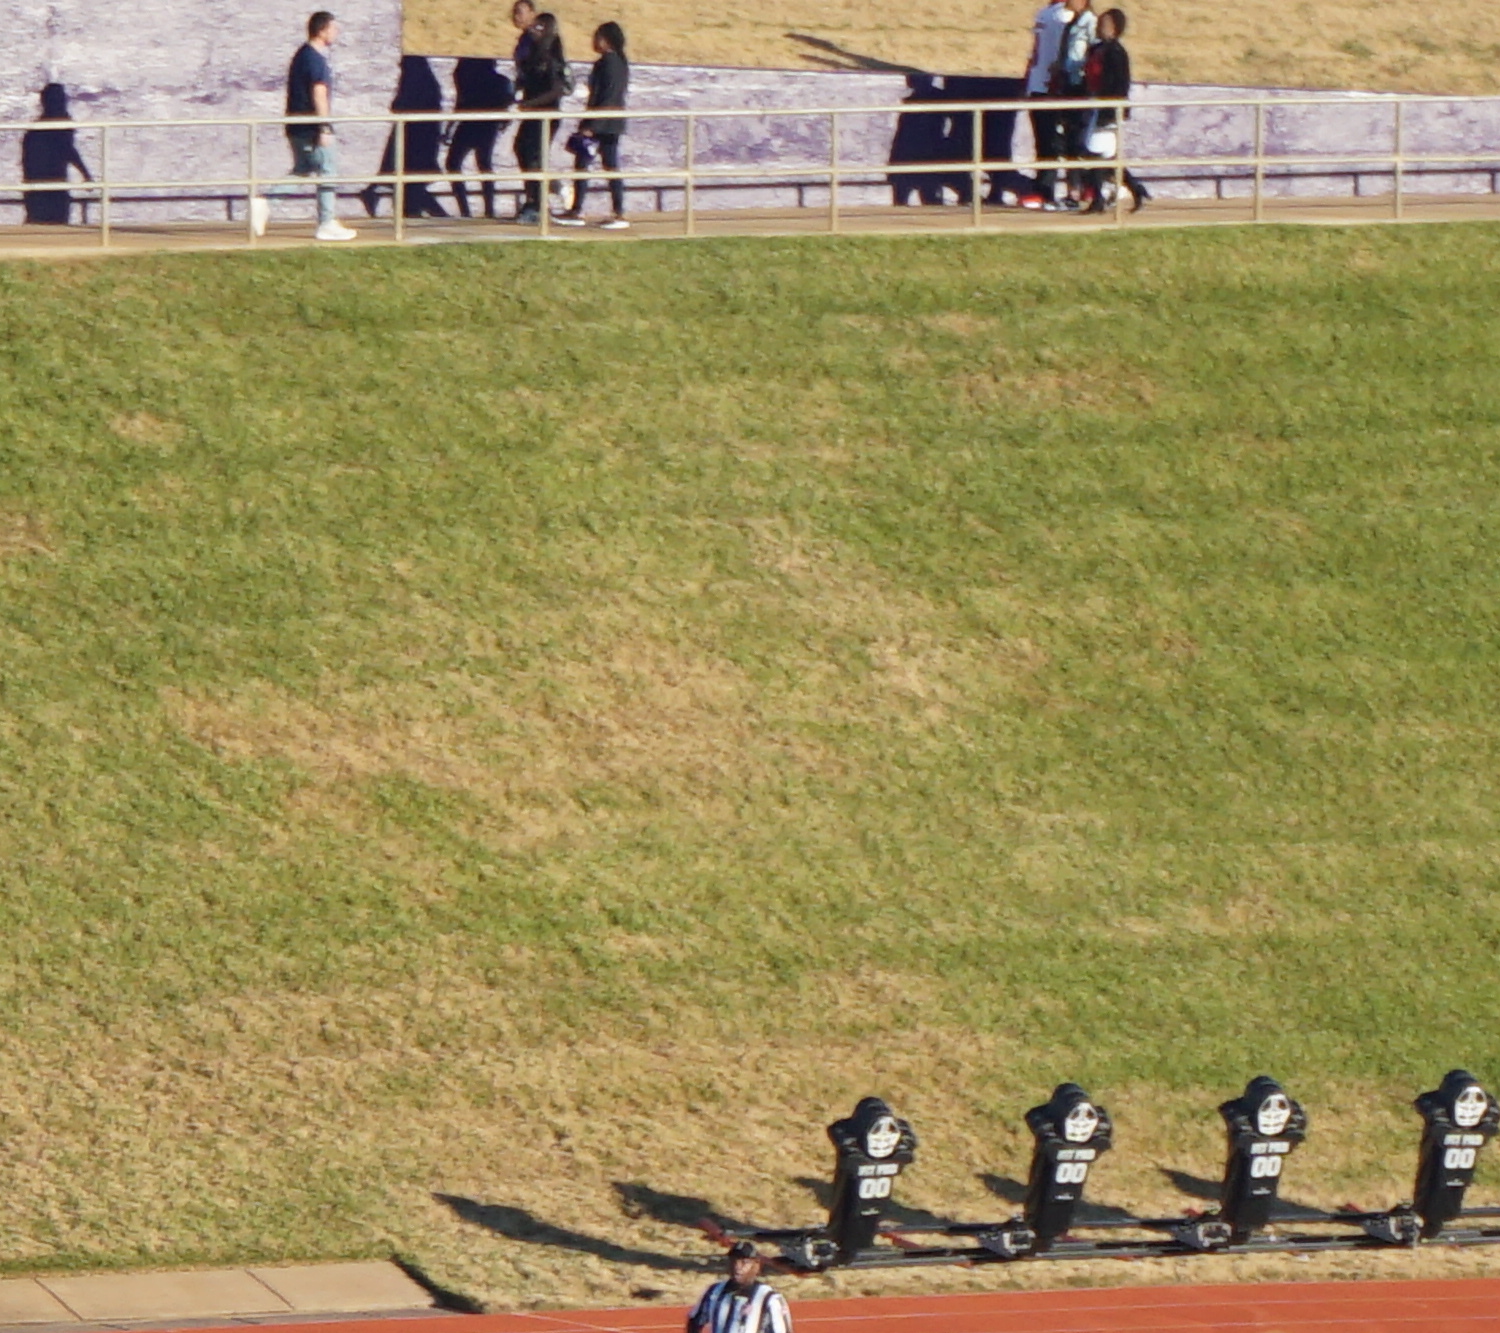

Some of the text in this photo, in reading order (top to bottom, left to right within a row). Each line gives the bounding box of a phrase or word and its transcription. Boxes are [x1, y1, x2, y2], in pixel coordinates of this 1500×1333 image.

[1251, 1156, 1282, 1178] 00
[1444, 1148, 1476, 1170] 00
[1055, 1162, 1088, 1184] 00
[858, 1178, 891, 1199] 00
